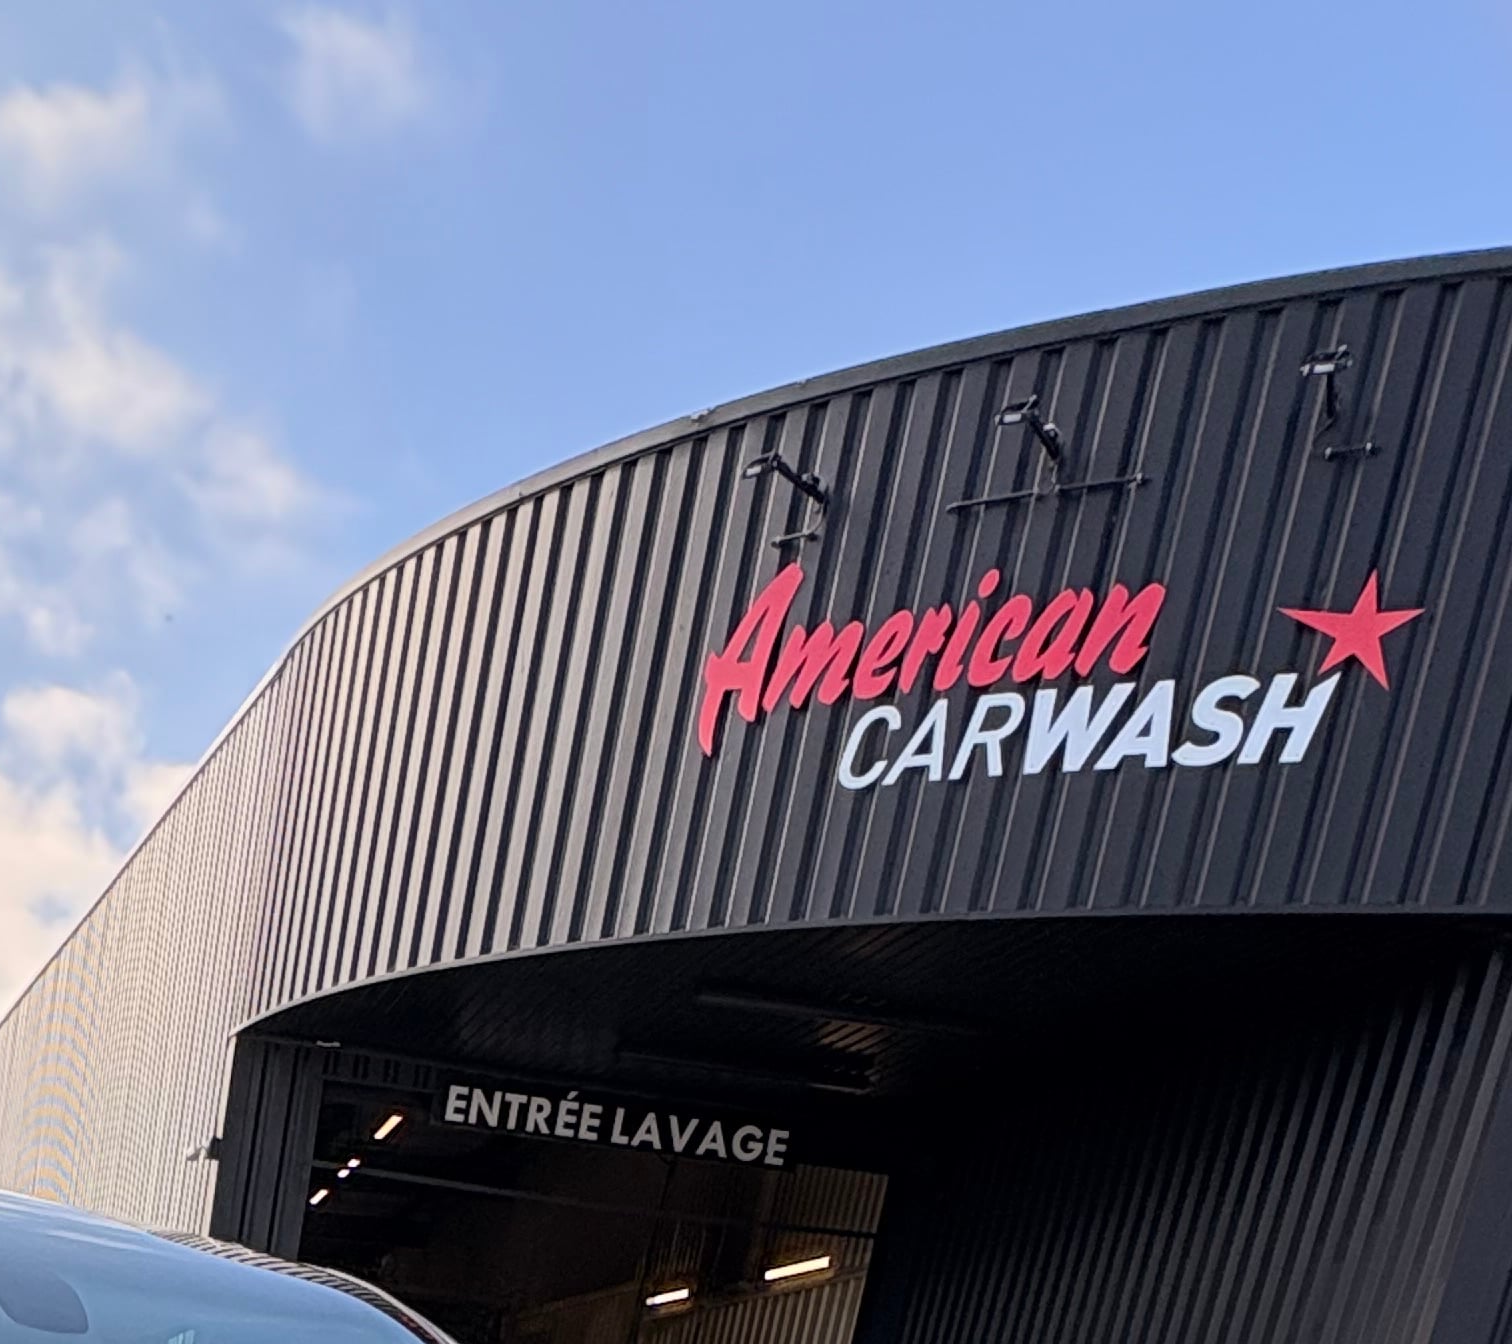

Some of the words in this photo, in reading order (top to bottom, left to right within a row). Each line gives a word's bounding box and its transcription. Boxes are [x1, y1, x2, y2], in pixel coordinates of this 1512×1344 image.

[698, 562, 1167, 757] American
[837, 670, 1341, 790] CARWASH
[444, 1084, 604, 1142] ENTRÉE
[611, 1106, 790, 1166] LAVAGE
